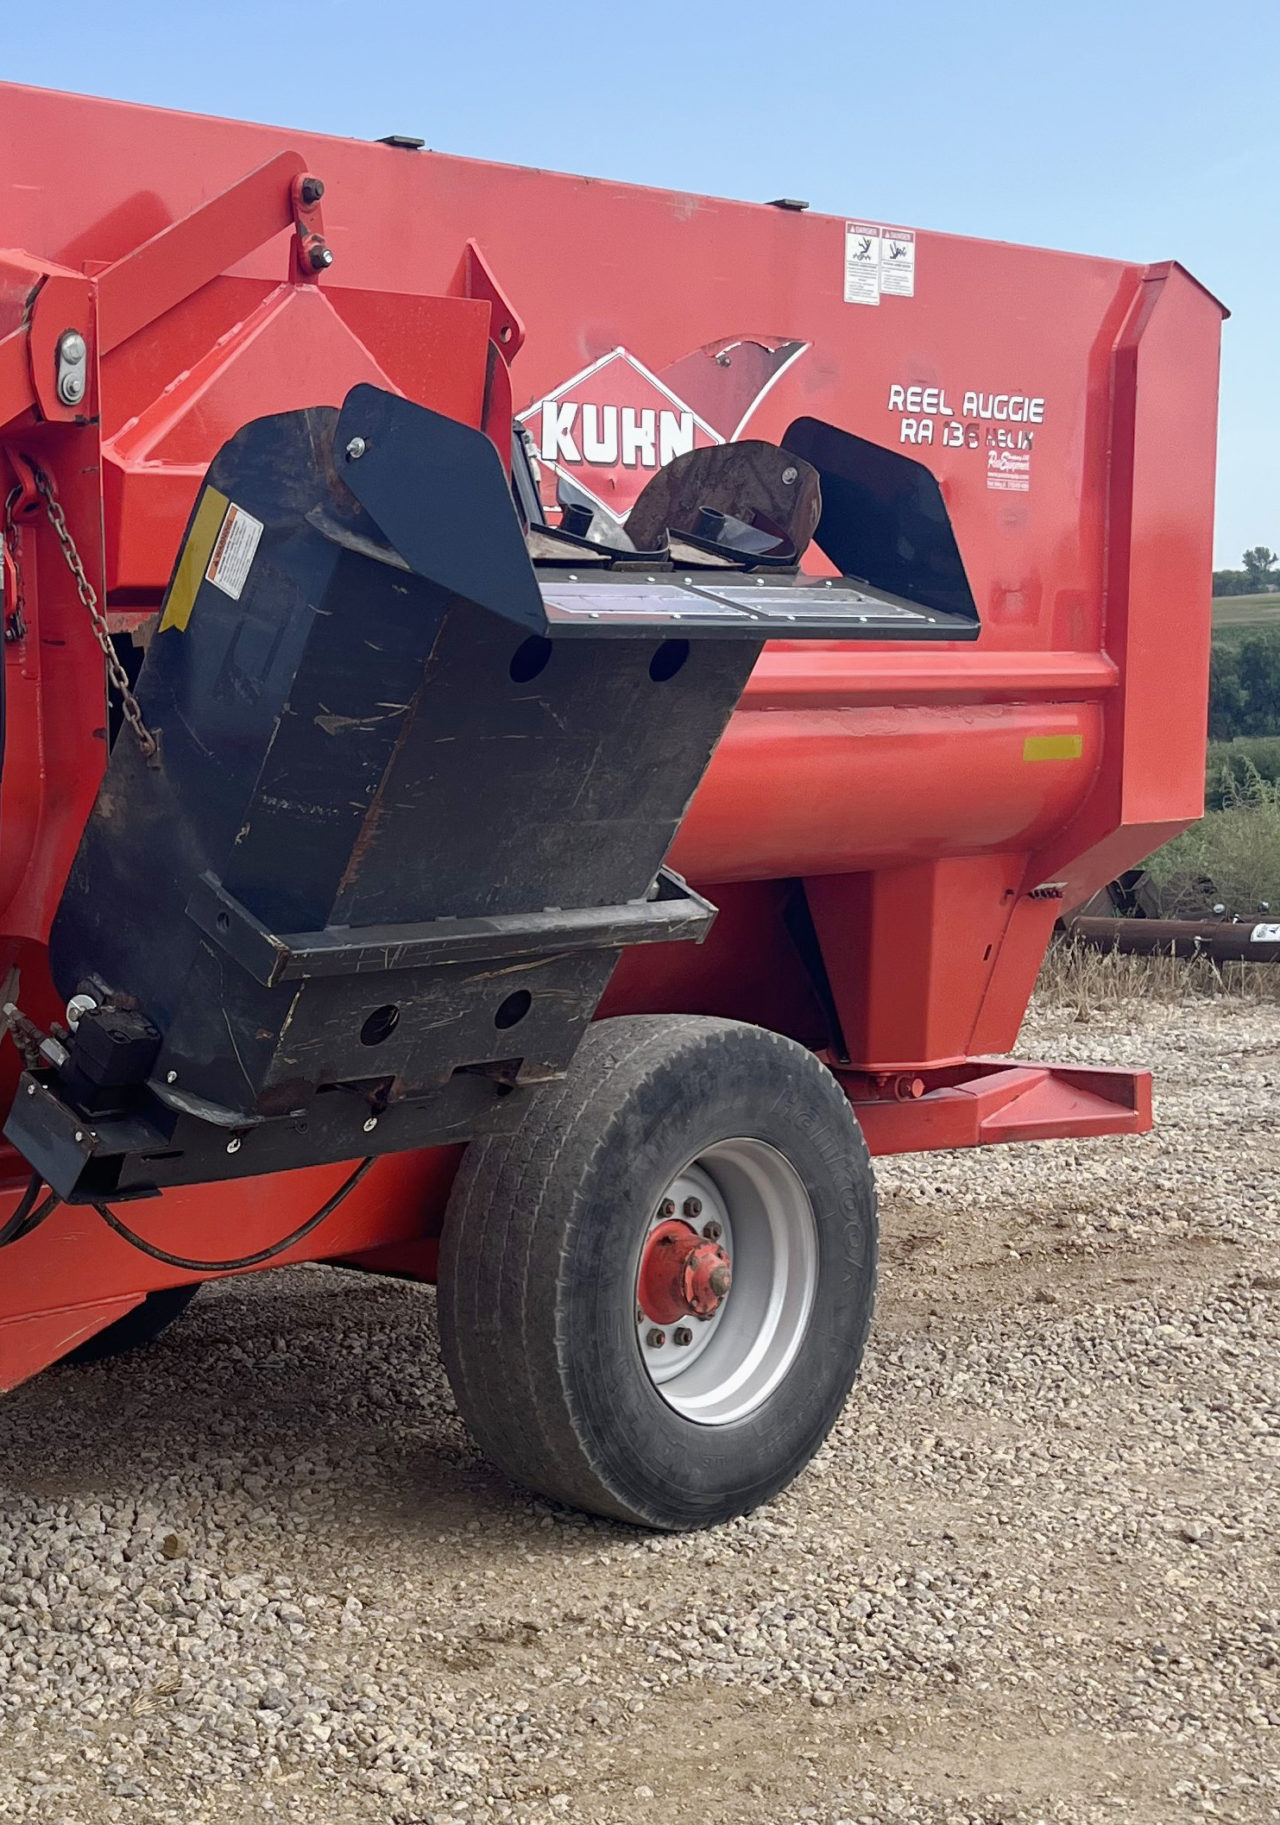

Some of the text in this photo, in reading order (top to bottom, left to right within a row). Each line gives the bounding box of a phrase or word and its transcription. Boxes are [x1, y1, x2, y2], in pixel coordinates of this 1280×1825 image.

[888, 384, 1046, 424] REEL AUGGIE
[541, 400, 695, 468] KUHN
[900, 418, 934, 445] RA
